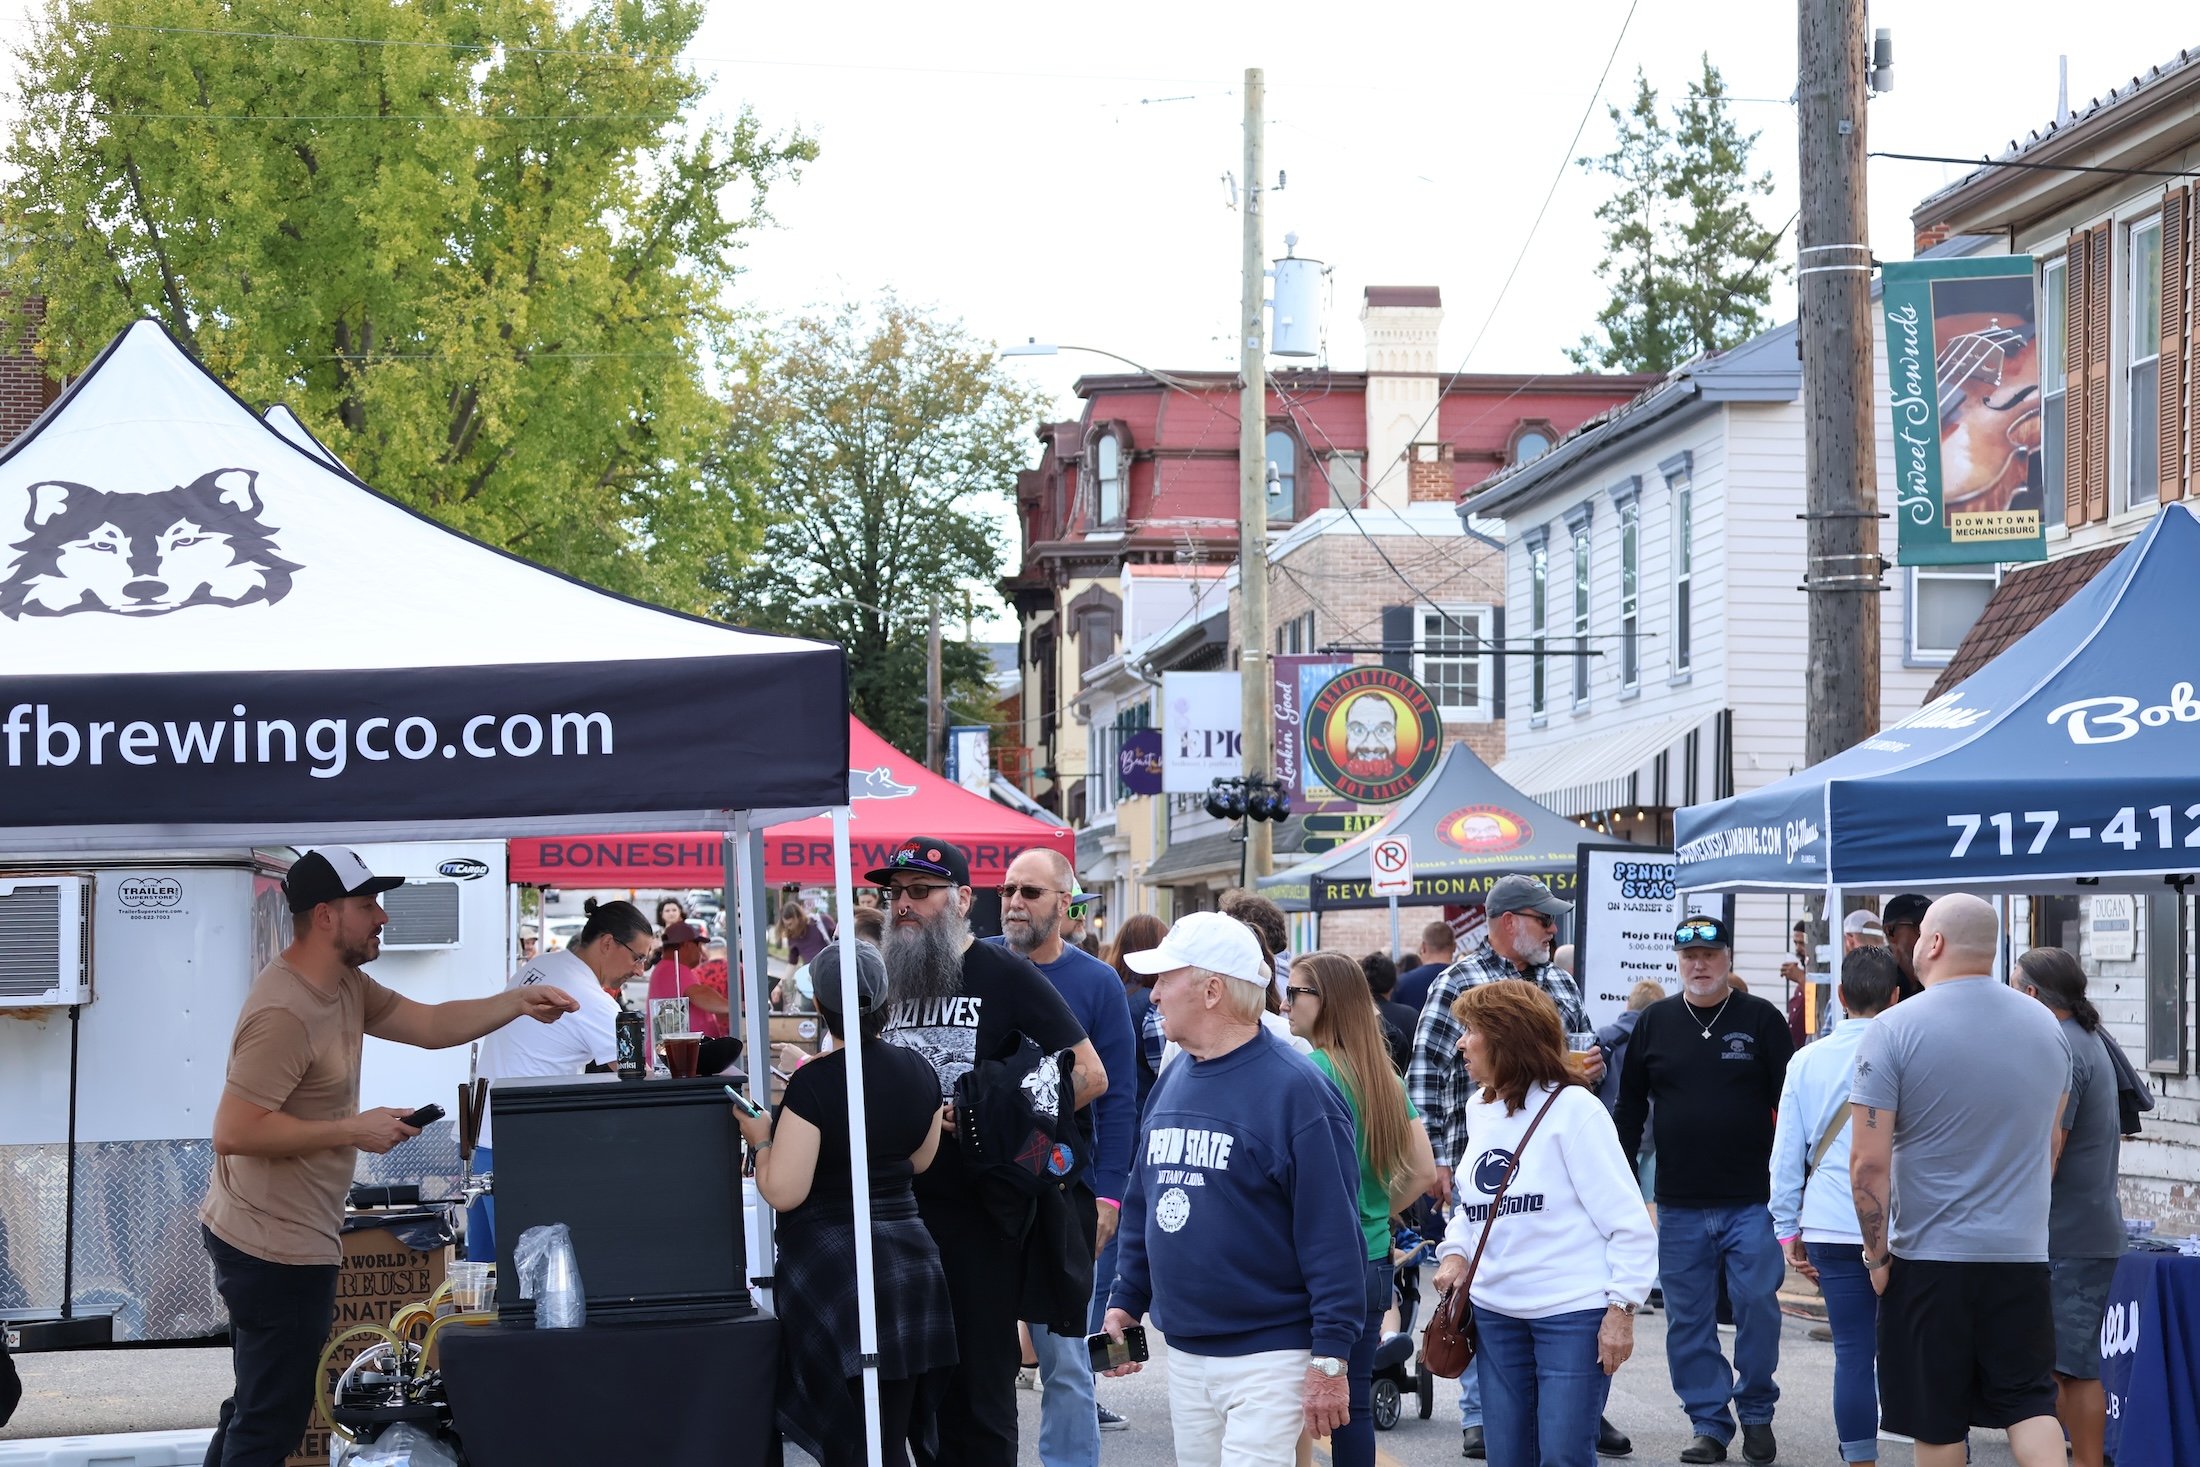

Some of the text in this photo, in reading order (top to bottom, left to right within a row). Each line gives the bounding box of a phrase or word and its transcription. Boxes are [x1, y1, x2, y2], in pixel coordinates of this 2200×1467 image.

[1888, 302, 1934, 526] Sweet Sounds
[1955, 515, 2036, 527] DOWNTOWN
[1955, 525, 2036, 537] MECHANICSBURG
[1274, 680, 1300, 725] Good
[1316, 670, 1432, 714] REVOLUTIONARY
[2047, 681, 2200, 745] Bob
[2, 703, 614, 779] fbrewingco.com
[1335, 773, 1416, 799] HOT SAUCE
[539, 842, 768, 868] BONESHI
[1607, 902, 1620, 912] ON
[1623, 902, 1663, 913] MARKET
[2095, 898, 2126, 918] DUGAN
[1622, 931, 1651, 941] Mojo
[1628, 942, 1664, 952] 5:00-6:00
[1620, 960, 1663, 971] Pucker
[922, 996, 982, 1028] LIVES
[1184, 1128, 1235, 1171] STATE
[351, 1254, 407, 1270] WORLD
